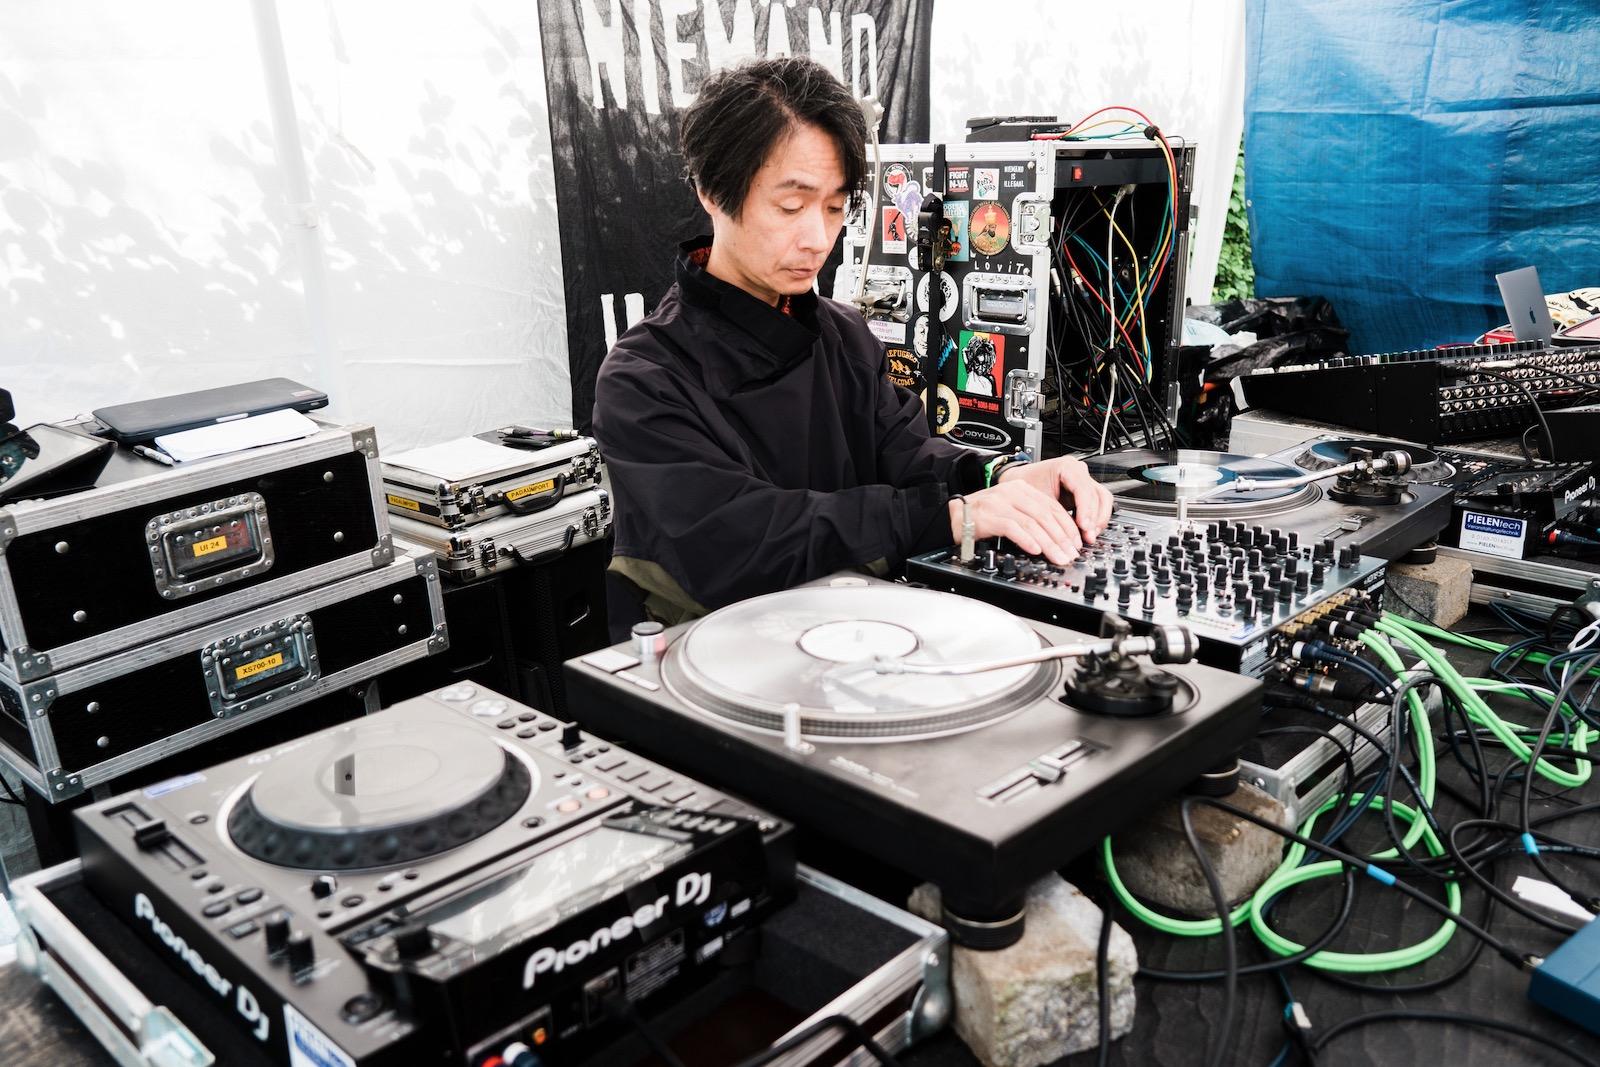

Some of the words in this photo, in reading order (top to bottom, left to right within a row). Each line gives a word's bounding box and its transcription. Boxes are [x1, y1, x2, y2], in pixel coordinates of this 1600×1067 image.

[949, 171, 968, 180] FIGHT
[949, 179, 968, 189] N-VA
[1564, 482, 1588, 505] Pioneer
[1467, 515, 1521, 530] PIELENtech
[210, 541, 219, 550] 24
[242, 657, 276, 675] XS700-10
[134, 892, 233, 998] Pioneer
[522, 894, 669, 990] Pioneer
